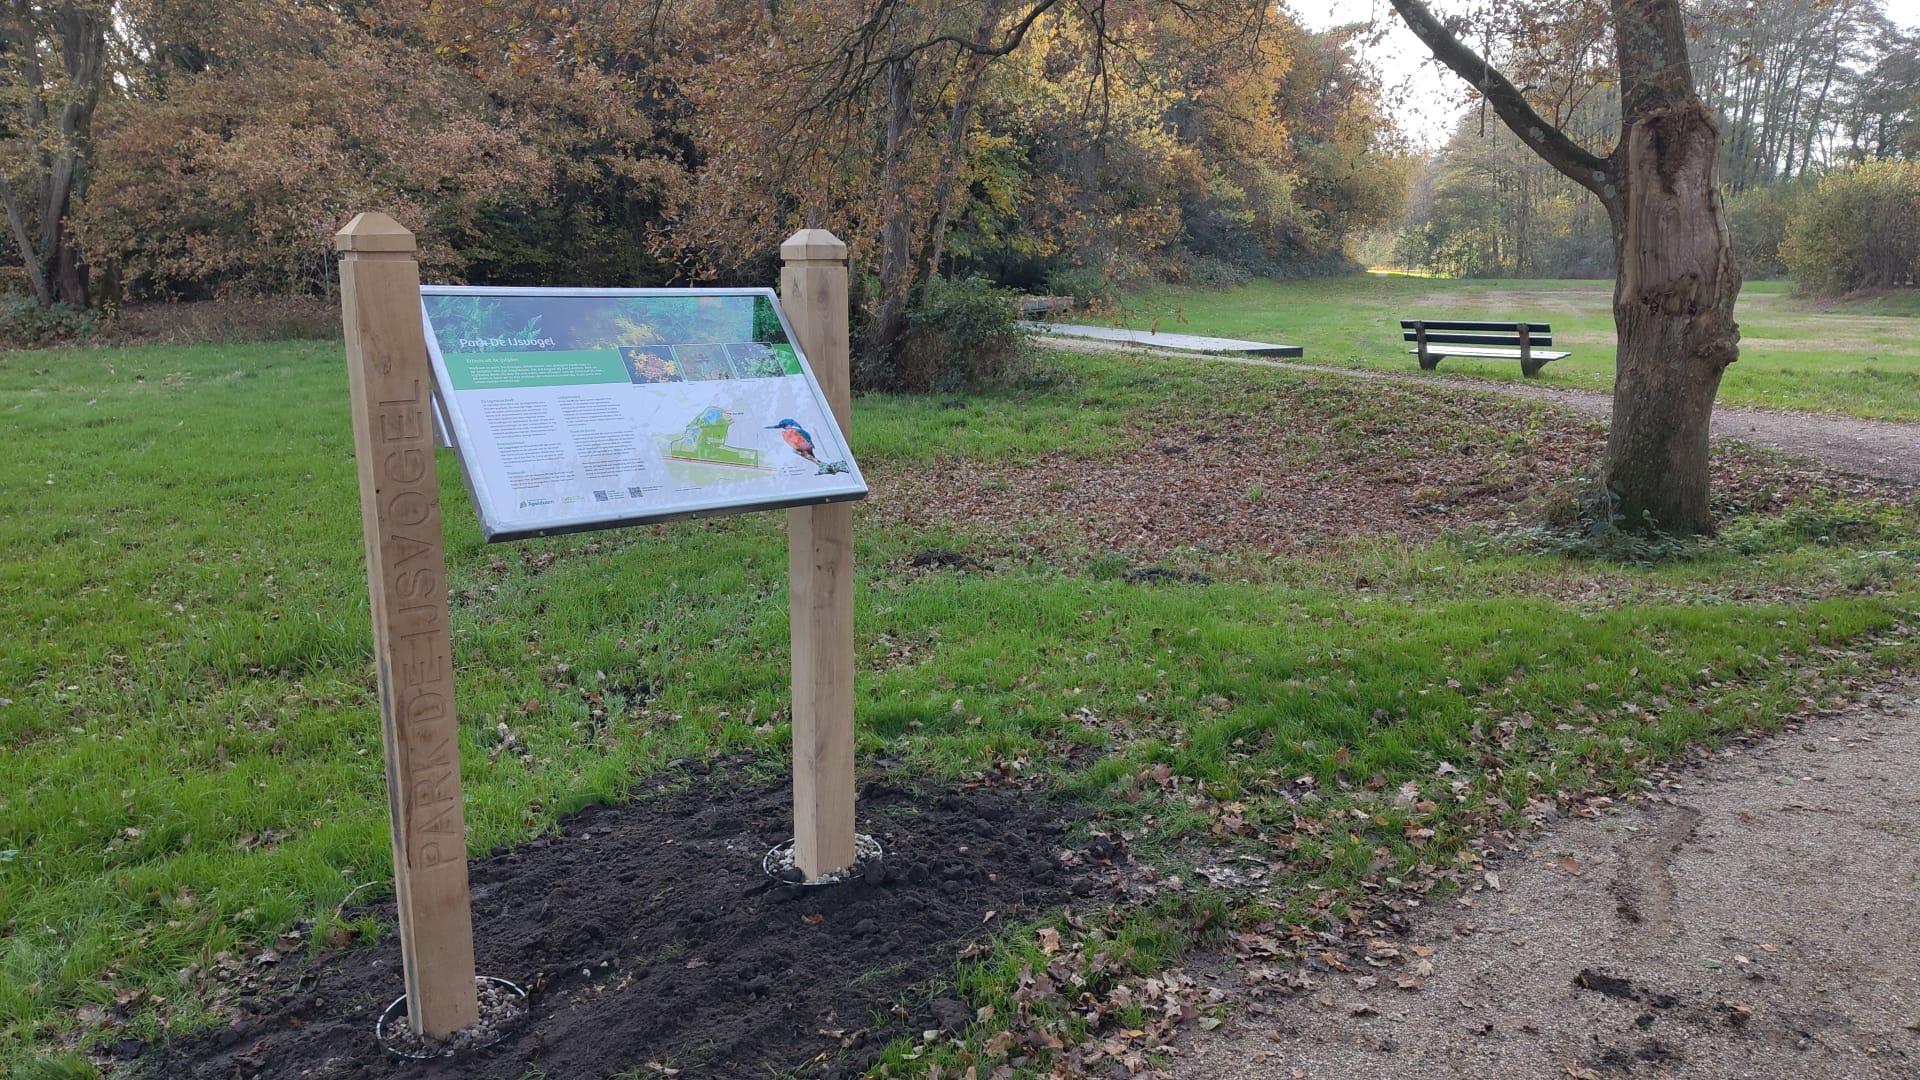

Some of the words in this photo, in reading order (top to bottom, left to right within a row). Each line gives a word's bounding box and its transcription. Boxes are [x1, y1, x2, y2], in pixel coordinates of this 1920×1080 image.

[460, 338, 489, 348] Park
[491, 338, 507, 347] De
[378, 379, 441, 641] IJSVOGEL
[402, 655, 446, 727] DE
[411, 736, 459, 871] PARK
